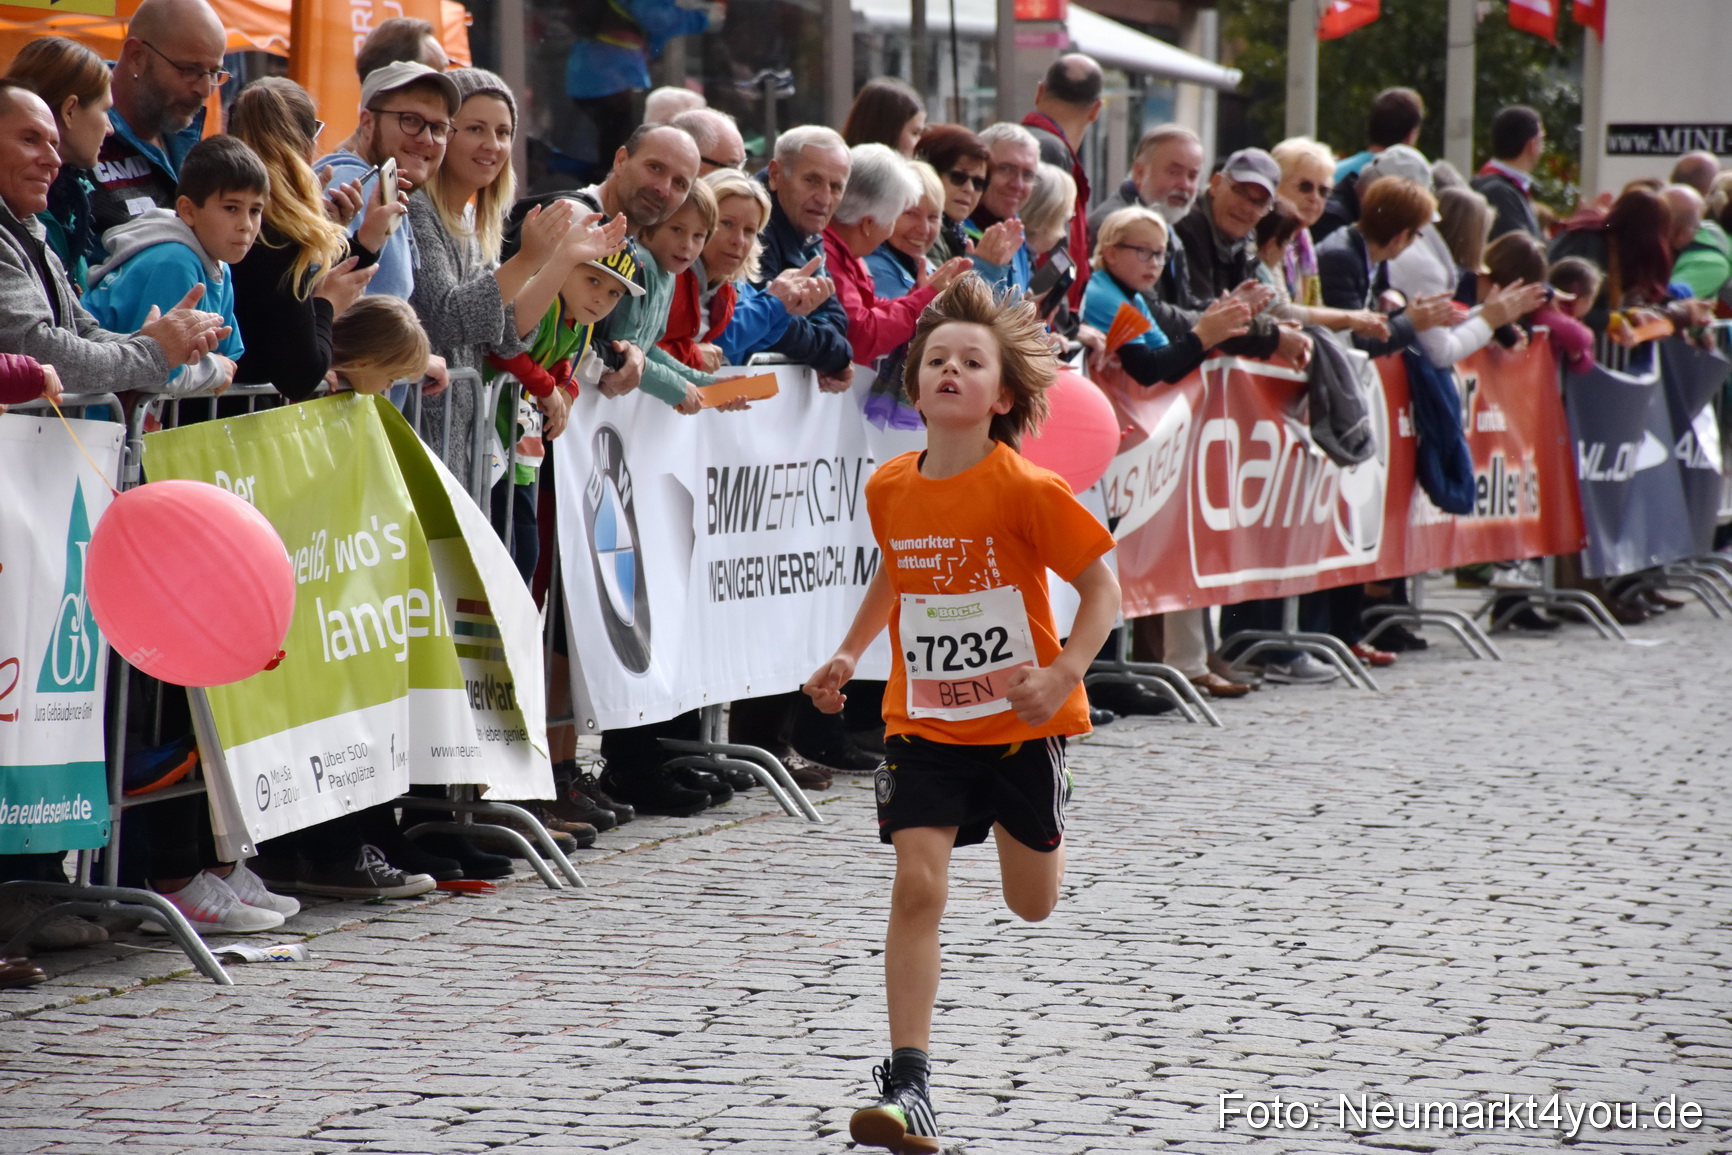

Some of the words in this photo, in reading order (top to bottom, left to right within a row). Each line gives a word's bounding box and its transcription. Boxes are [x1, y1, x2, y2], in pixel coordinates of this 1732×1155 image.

[597, 251, 636, 280] ORK
[587, 433, 632, 513] BMW
[334, 514, 407, 573] wo's
[938, 602, 983, 618] BOCK
[916, 626, 1014, 672] 7232
[938, 676, 995, 707] BEN
[323, 751, 346, 768] über
[347, 742, 368, 762] 500
[328, 764, 376, 790] Parkplätze
